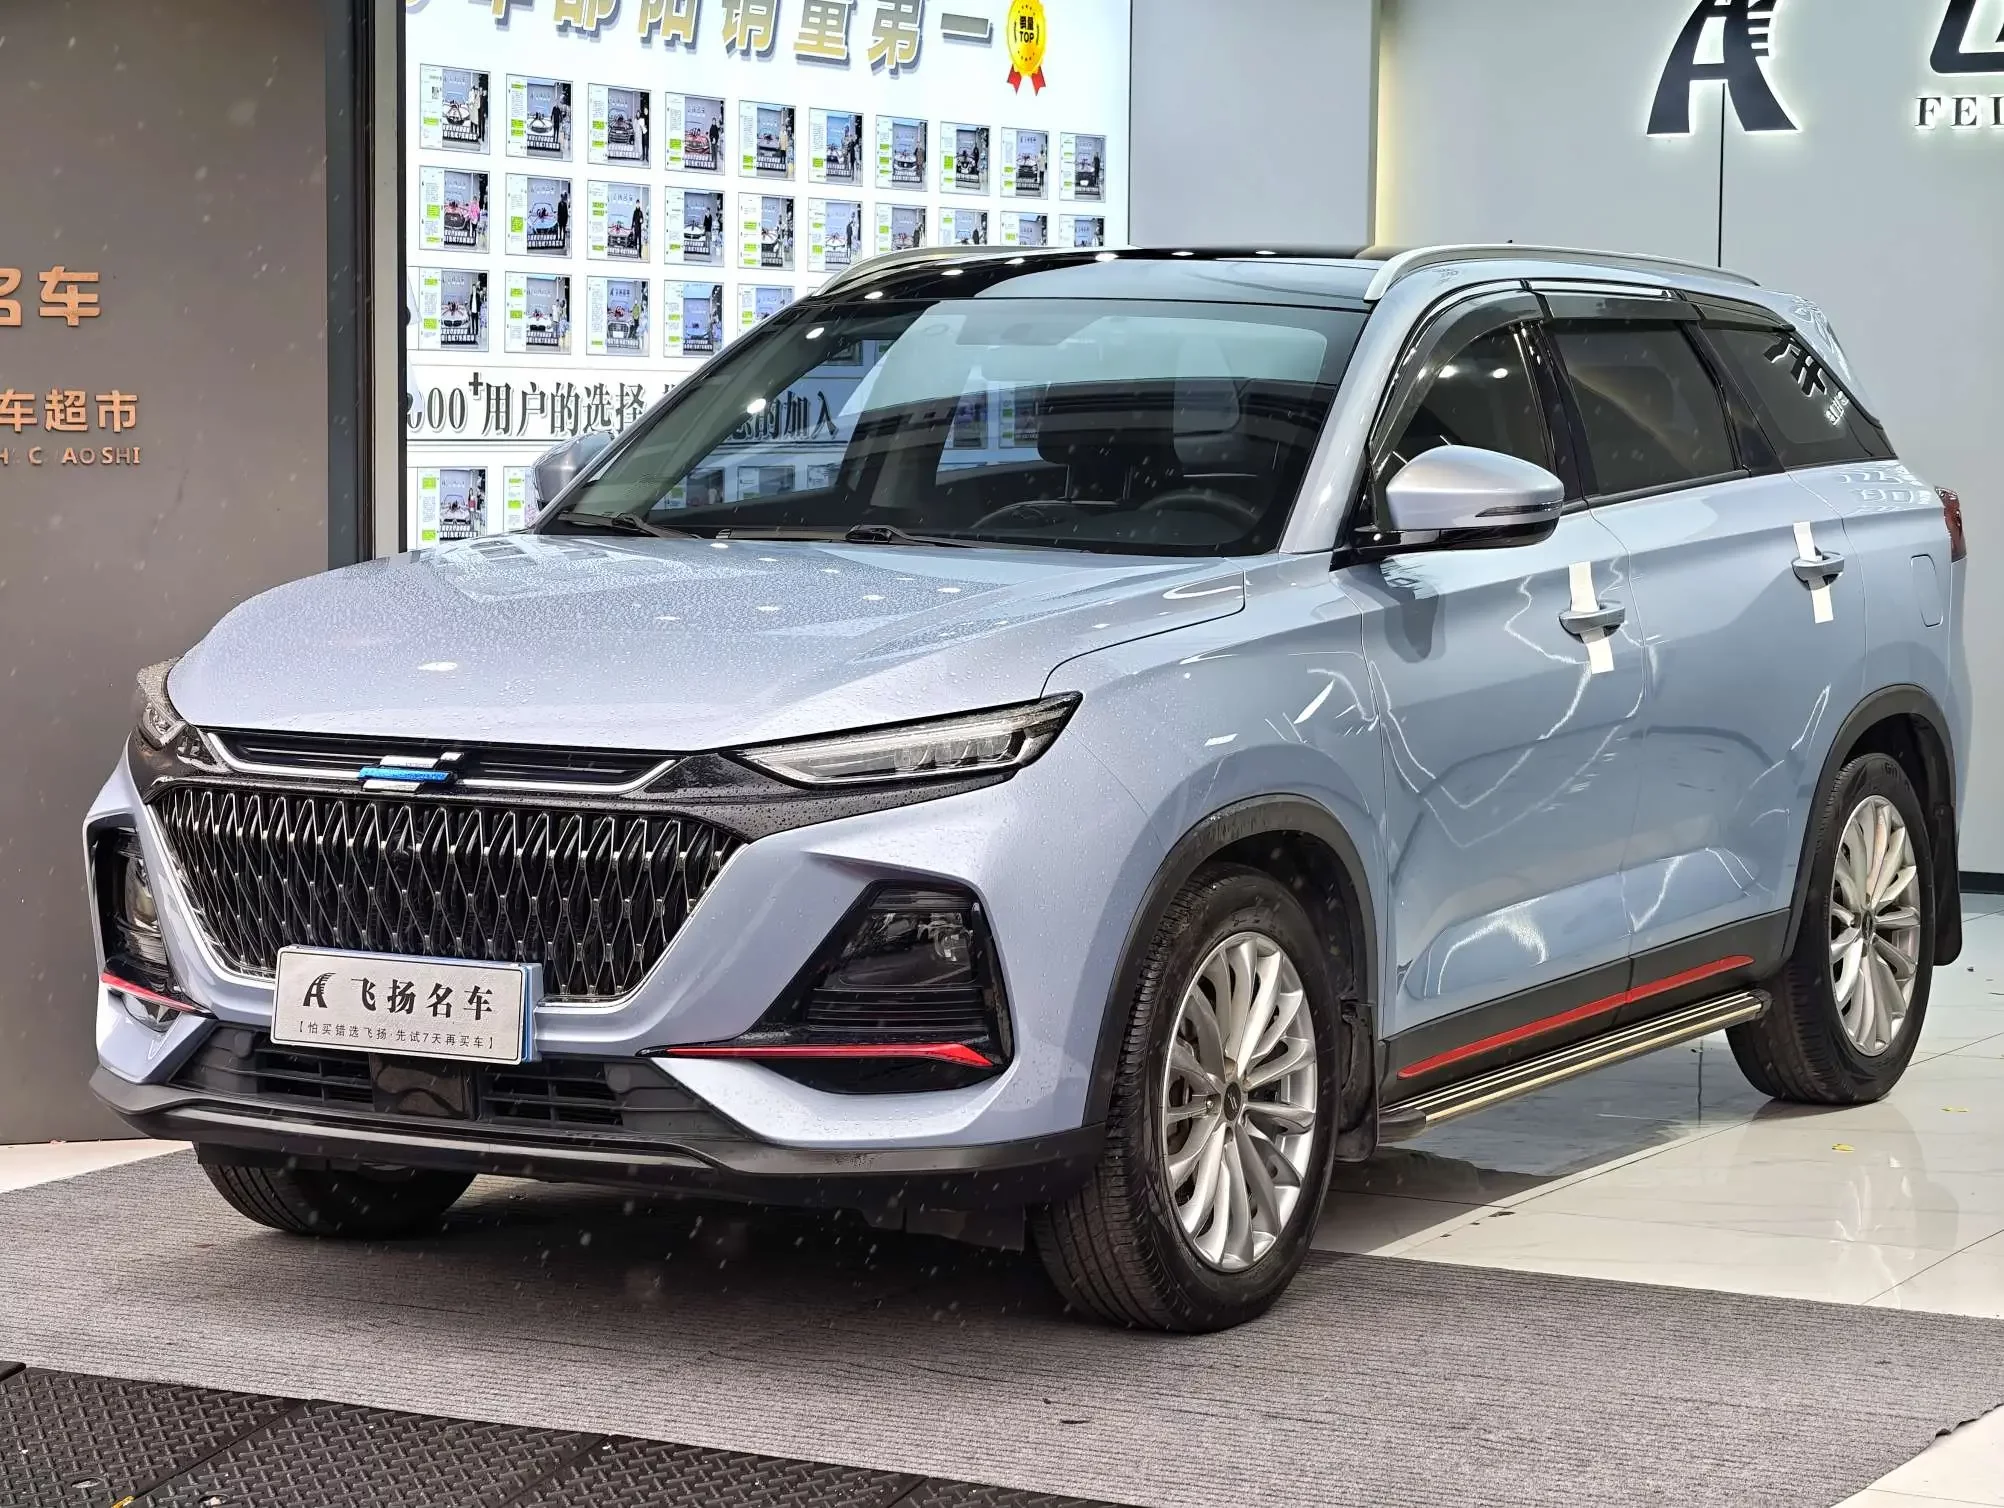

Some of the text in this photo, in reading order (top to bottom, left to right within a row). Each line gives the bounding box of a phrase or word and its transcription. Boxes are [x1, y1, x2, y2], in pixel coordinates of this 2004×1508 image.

[1020, 31, 1034, 43] TOP
[0, 389, 138, 433] 车超市
[351, 976, 493, 1021] 飞扬名车
